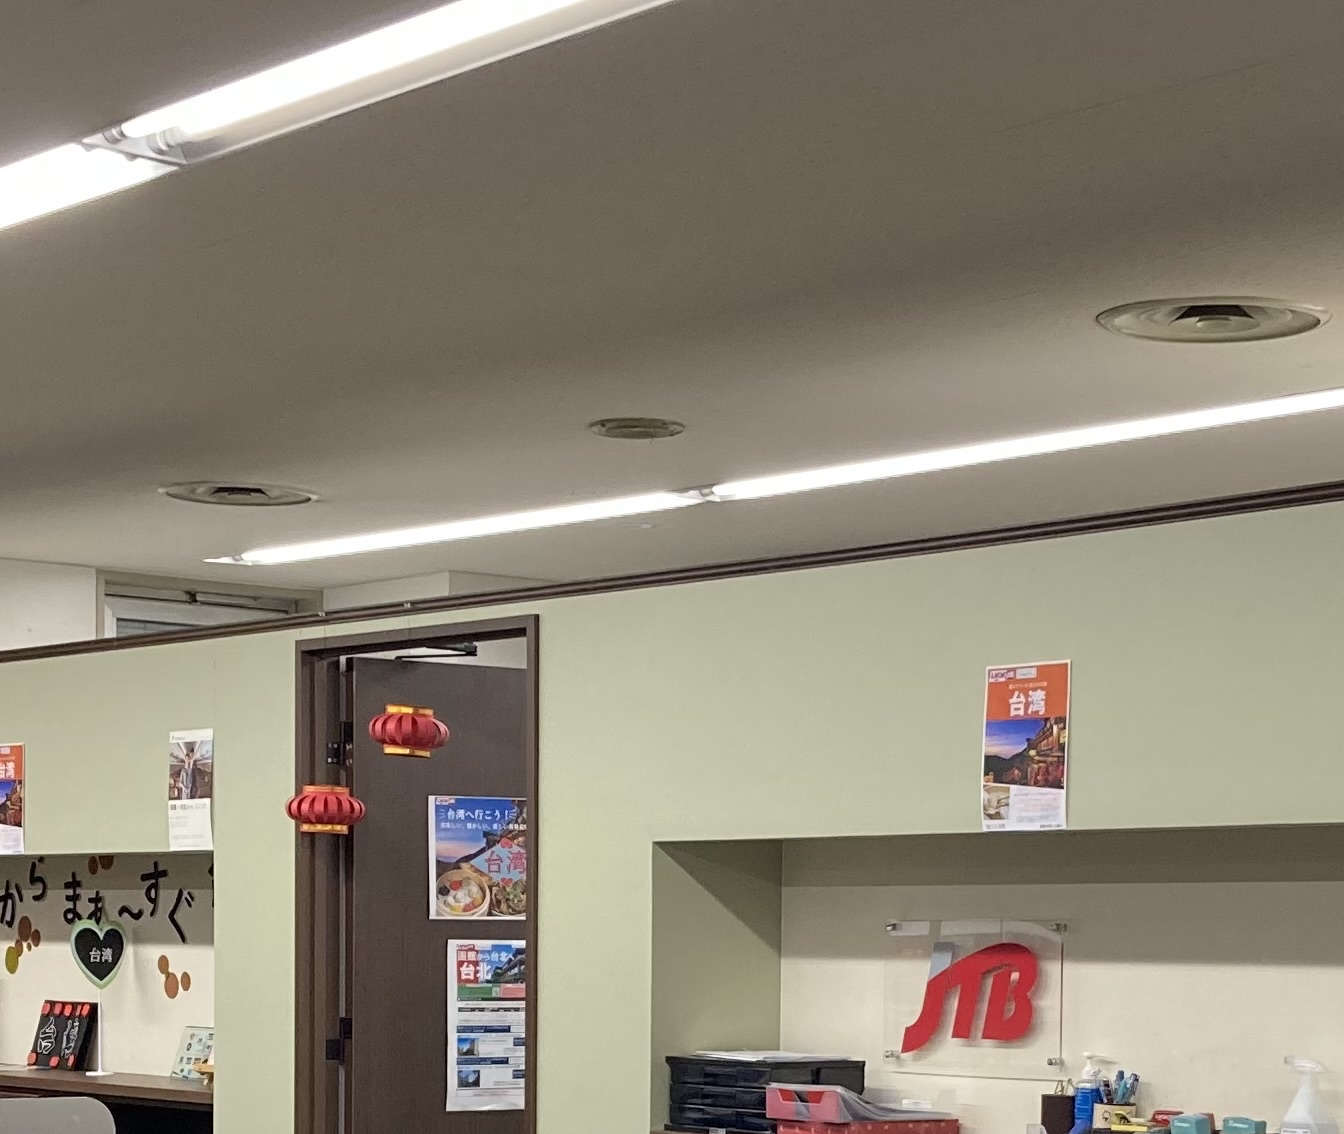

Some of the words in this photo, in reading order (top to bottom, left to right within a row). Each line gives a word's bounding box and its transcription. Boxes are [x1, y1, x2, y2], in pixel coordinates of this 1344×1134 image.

[1009, 689, 1046, 716] 台湾
[485, 850, 526, 874] 台湾
[89, 947, 113, 963] 台湾
[459, 962, 492, 980] 台北
[900, 941, 1038, 1054] JTB
